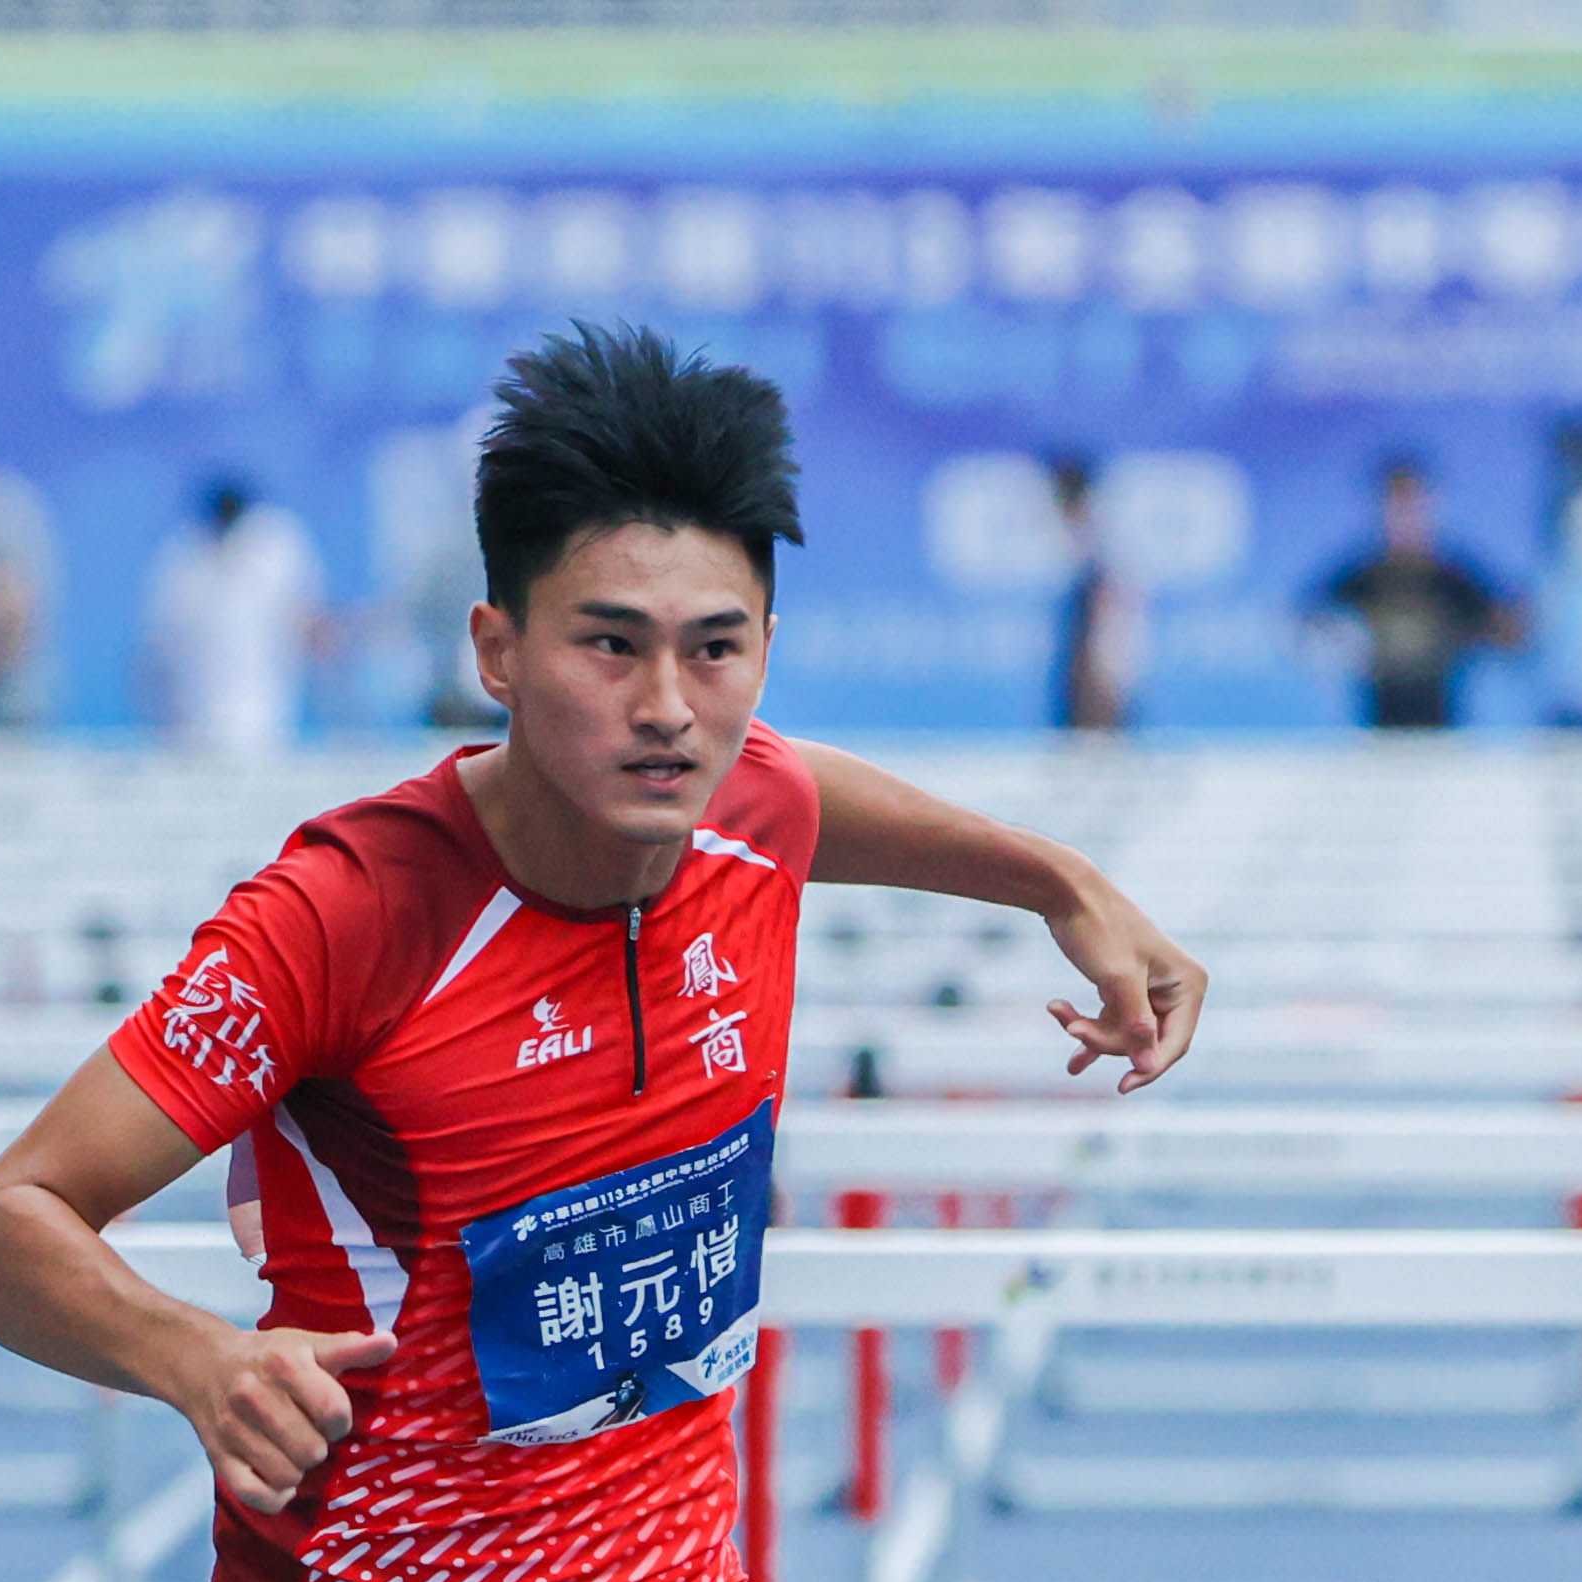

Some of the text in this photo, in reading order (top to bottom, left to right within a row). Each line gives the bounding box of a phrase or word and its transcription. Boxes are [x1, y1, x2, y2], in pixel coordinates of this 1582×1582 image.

[516, 1024, 593, 1069] EALI
[542, 1178, 735, 1265] 高雄市鳳山商工
[533, 1214, 739, 1347] 謝元愷
[587, 1296, 715, 1371] 1589
